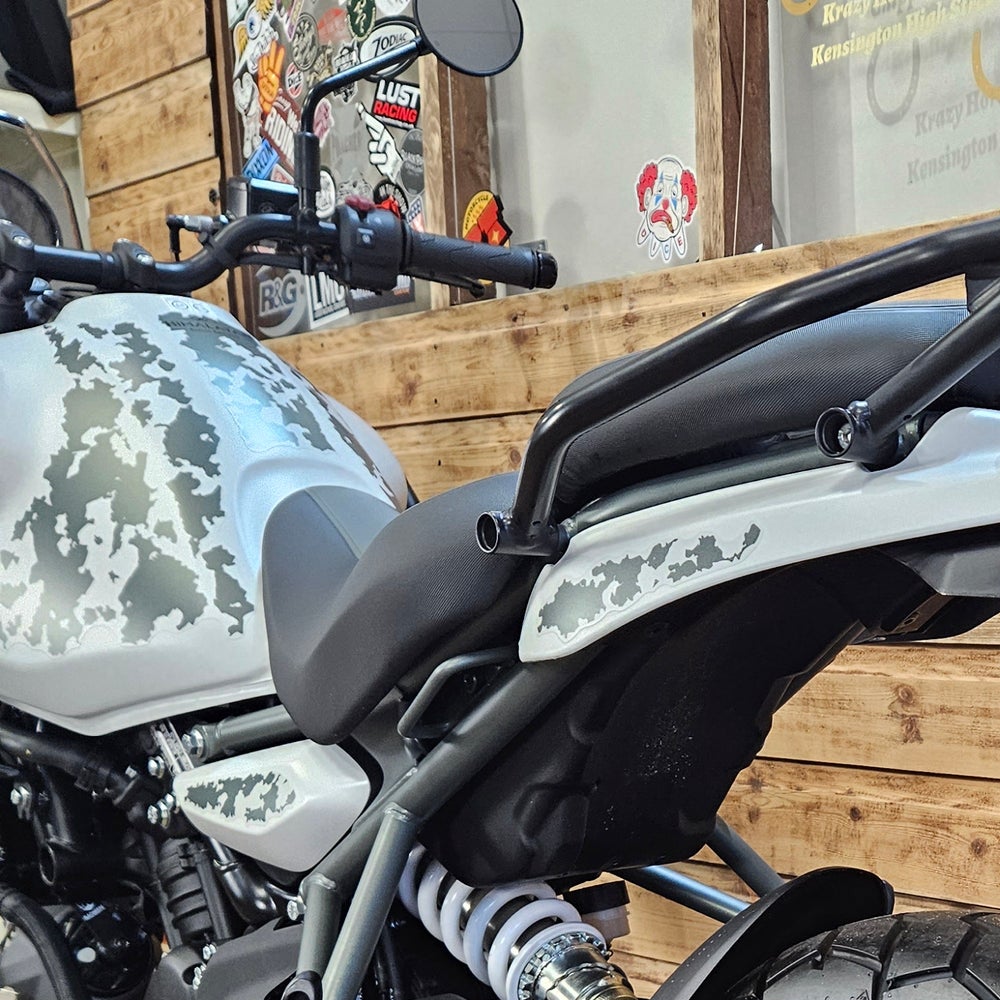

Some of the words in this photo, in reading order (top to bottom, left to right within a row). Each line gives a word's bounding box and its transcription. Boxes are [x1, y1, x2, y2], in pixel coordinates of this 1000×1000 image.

[811, 22, 902, 67] Kensington
[373, 101, 418, 123] RACING
[376, 79, 420, 108] LUST
[907, 132, 998, 184] Kensington
[259, 273, 297, 315] R&G
